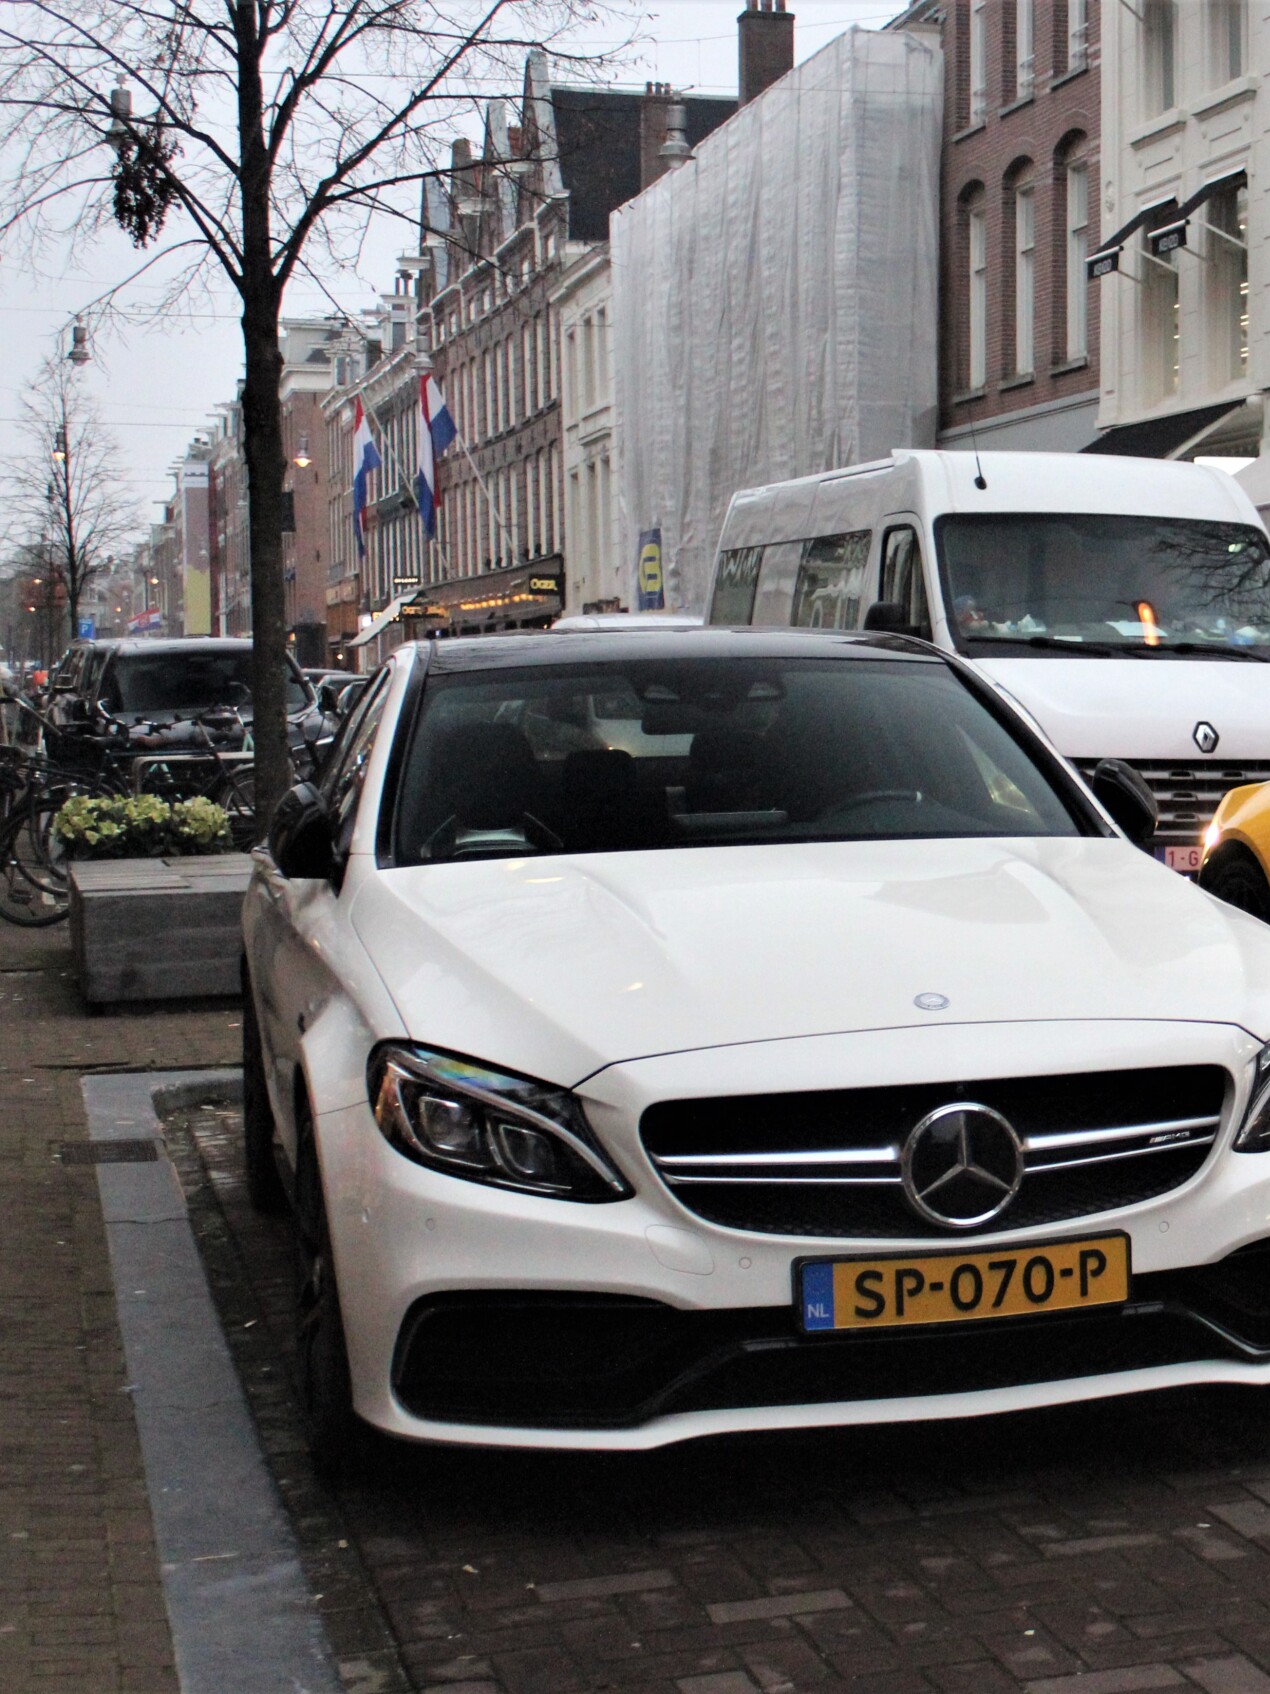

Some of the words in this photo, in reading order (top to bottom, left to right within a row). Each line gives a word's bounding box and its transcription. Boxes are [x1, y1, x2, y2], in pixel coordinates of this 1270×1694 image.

[81, 624, 88, 634] P
[807, 1303, 829, 1319] NL
[854, 1249, 1107, 1319] SP-070-P
